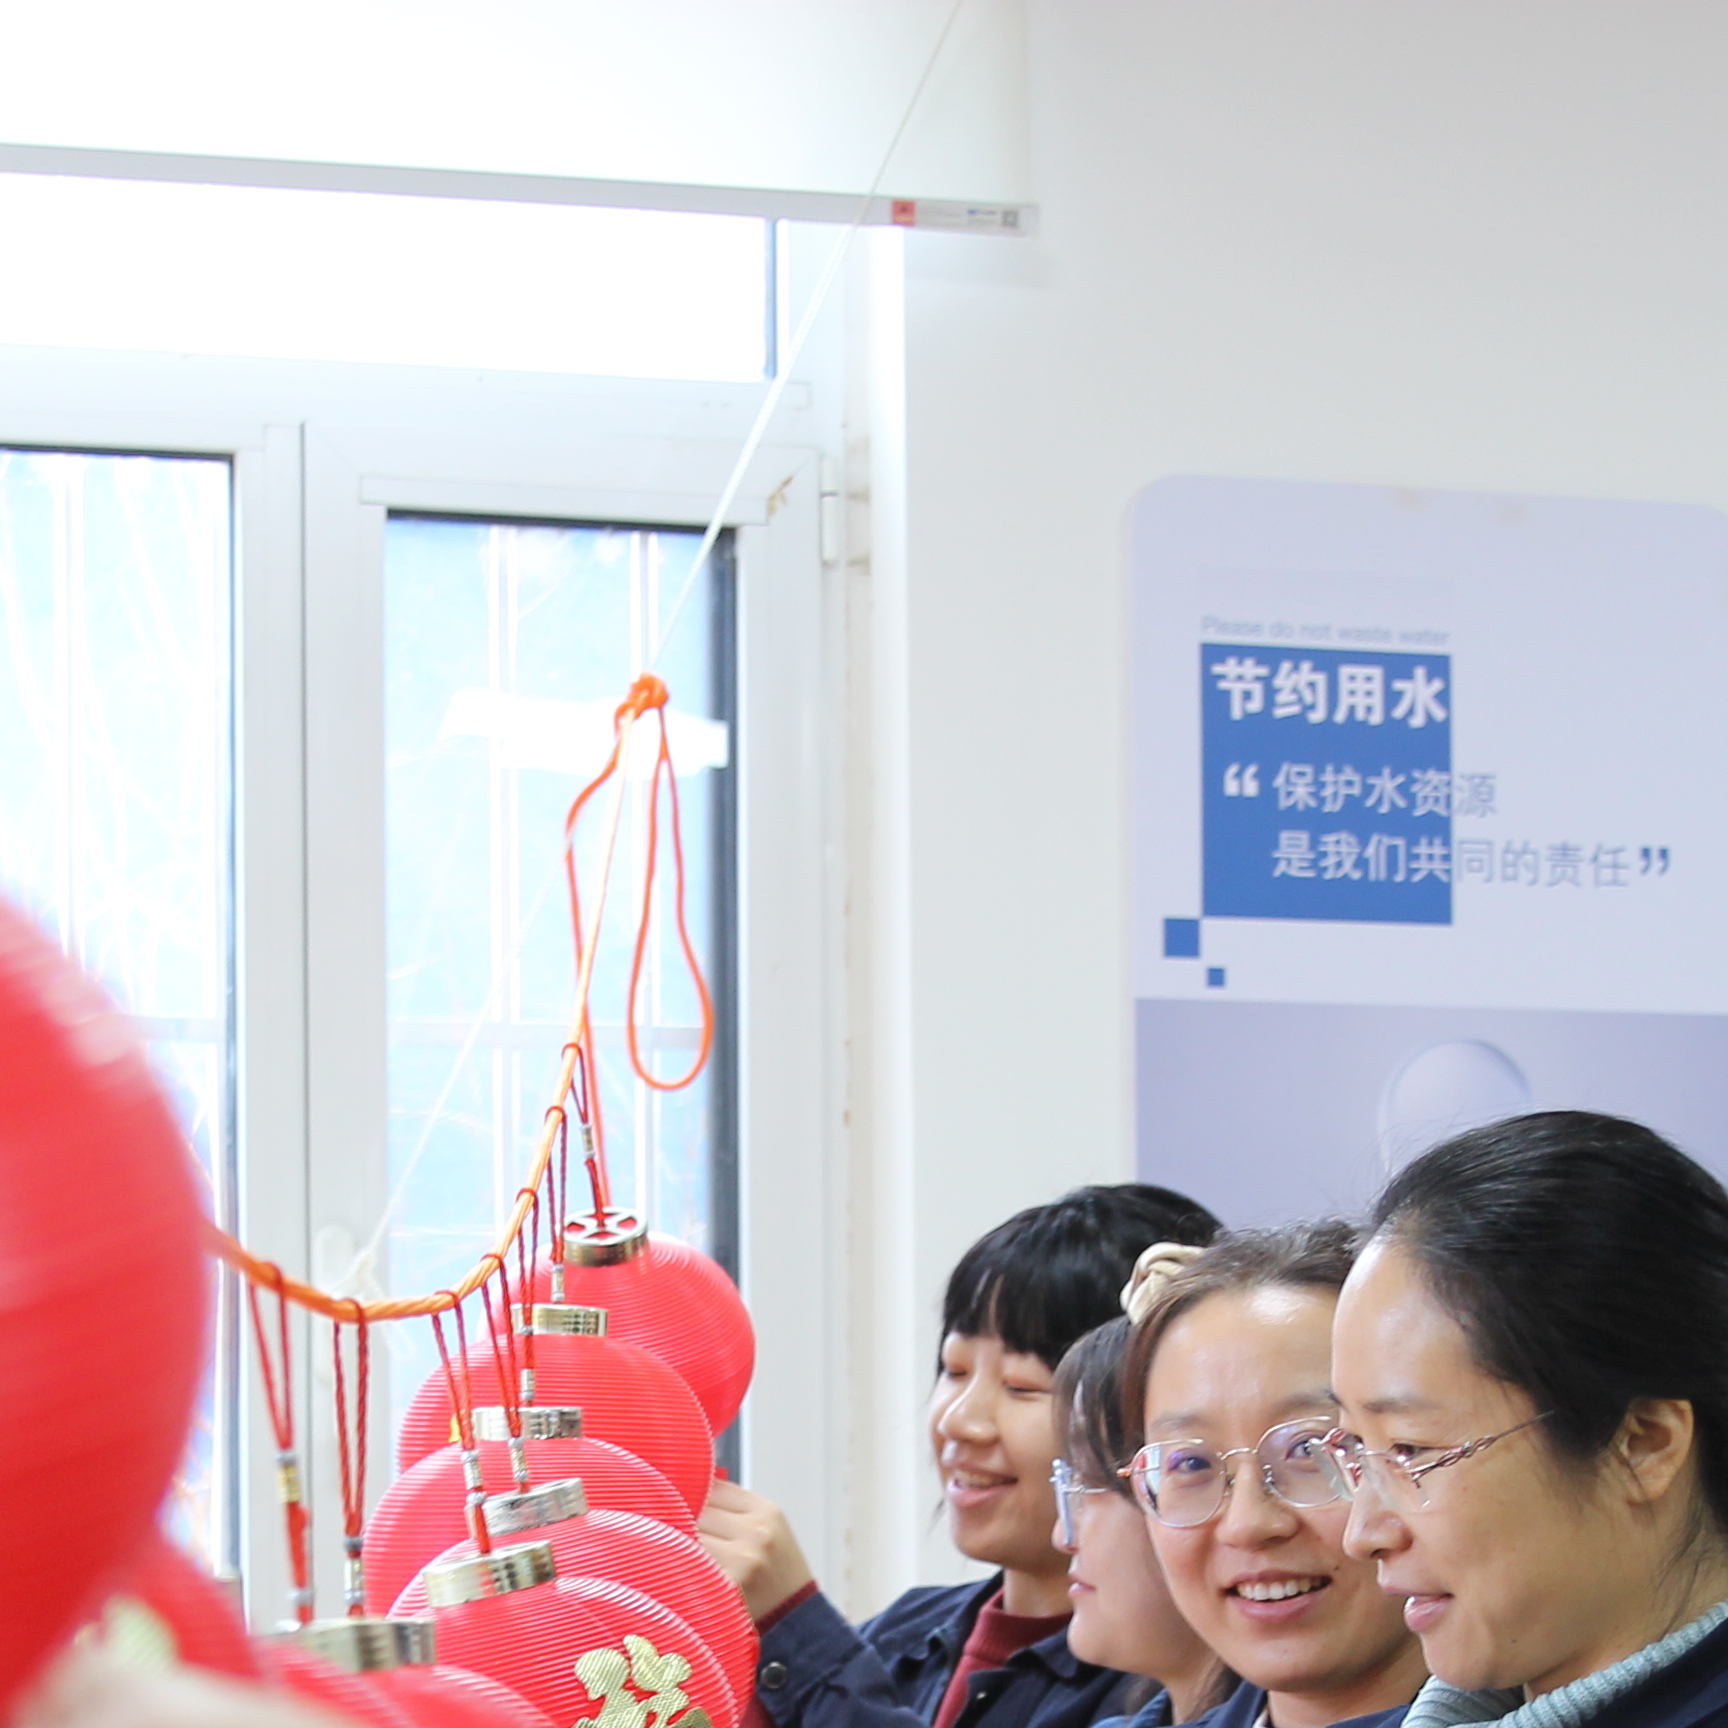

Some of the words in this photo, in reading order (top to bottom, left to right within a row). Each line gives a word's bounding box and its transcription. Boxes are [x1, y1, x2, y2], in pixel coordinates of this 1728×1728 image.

[1201, 615, 1263, 637] Please
[1269, 620, 1294, 638] do
[1300, 622, 1331, 640] not
[1339, 626, 1391, 643] waste
[1400, 629, 1450, 645] water
[1210, 656, 1448, 729] 节约用水
